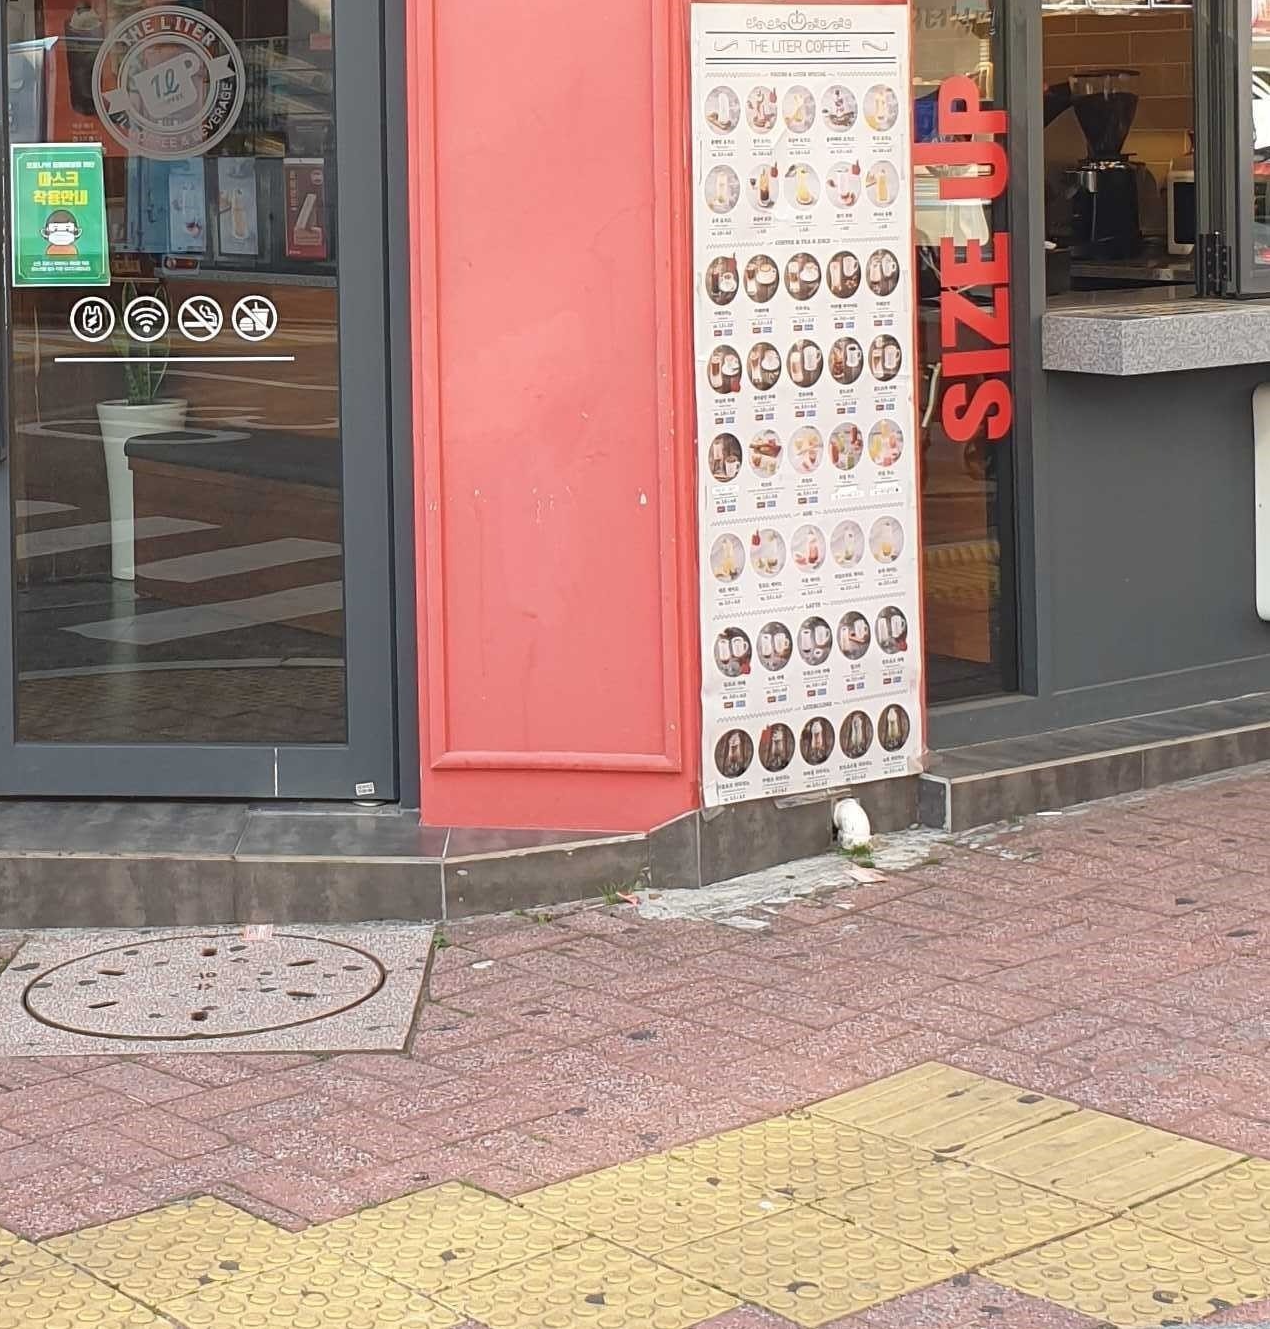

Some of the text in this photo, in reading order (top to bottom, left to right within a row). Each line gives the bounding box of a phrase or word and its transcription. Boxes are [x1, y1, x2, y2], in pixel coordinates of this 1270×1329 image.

[119, 15, 217, 47] THE LITER
[747, 39, 851, 54] THE LITER COFFEE
[38, 171, 79, 188] 마스크
[33, 189, 88, 207] 착용안내
[937, 74, 1012, 442] SIZE UP
